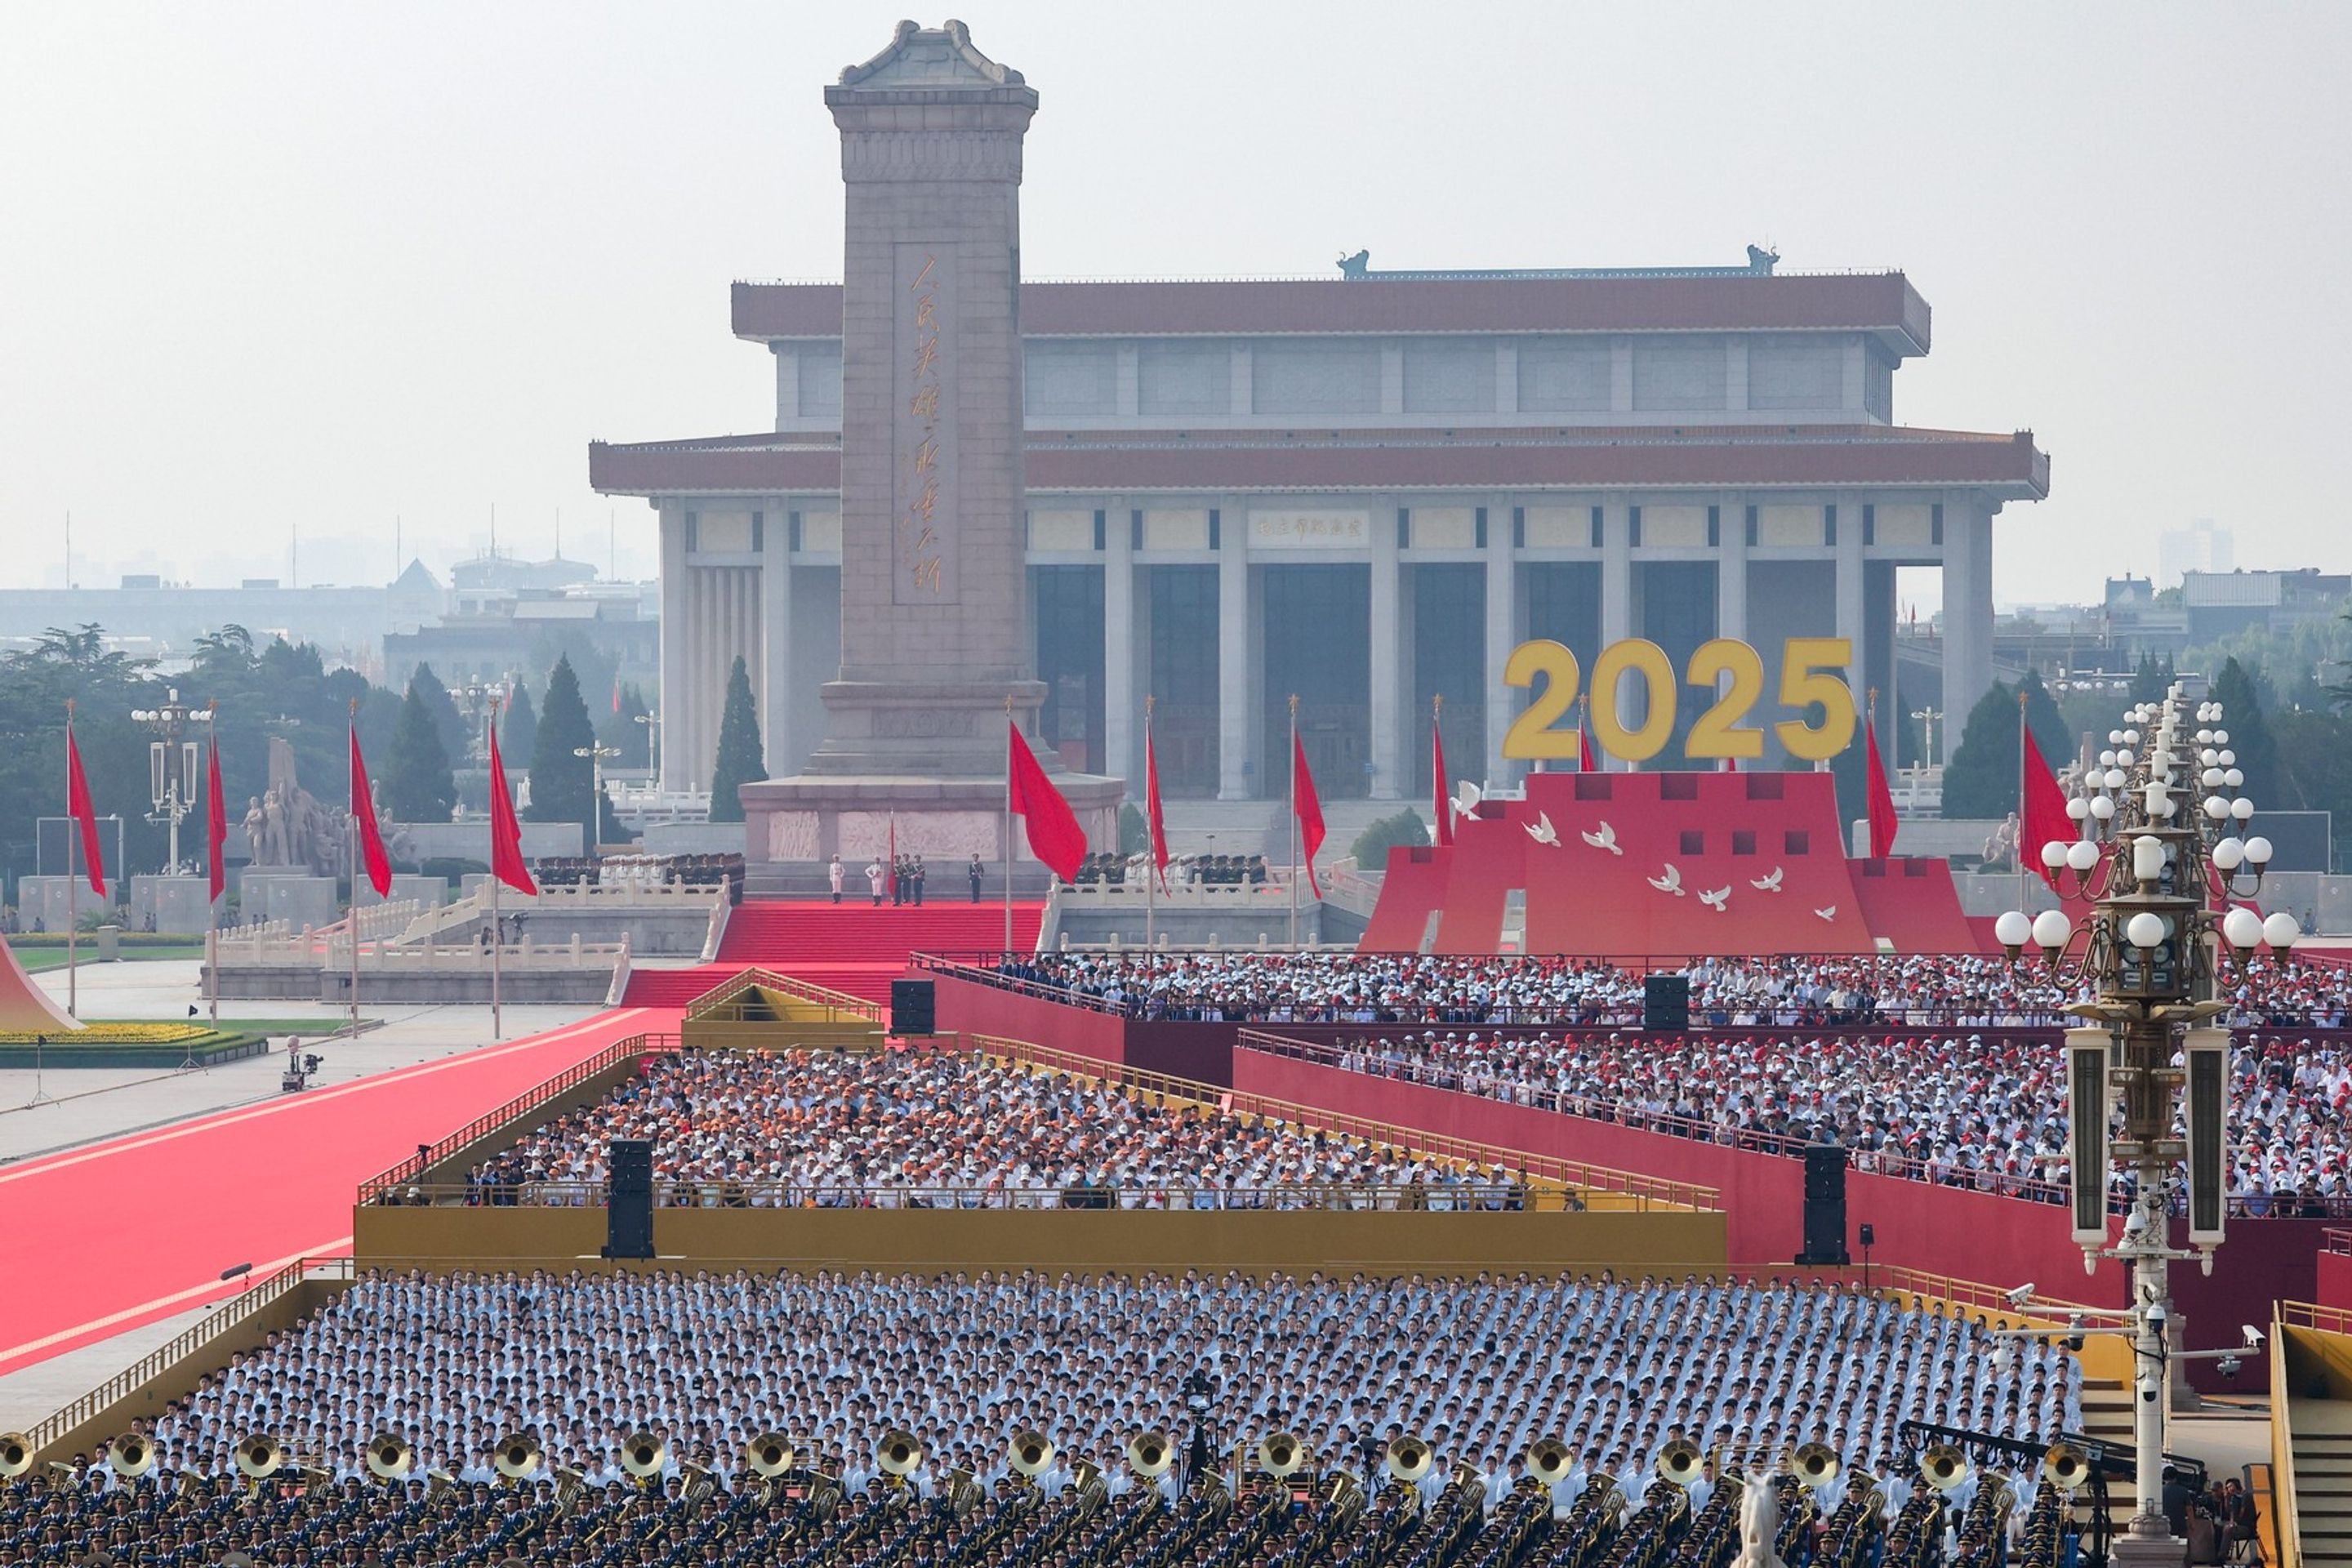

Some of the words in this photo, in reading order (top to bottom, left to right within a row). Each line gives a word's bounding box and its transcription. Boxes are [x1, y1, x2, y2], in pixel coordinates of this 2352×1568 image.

[910, 255, 942, 594] 人民英雄永垂不朽
[1502, 638, 1857, 761] 2025
